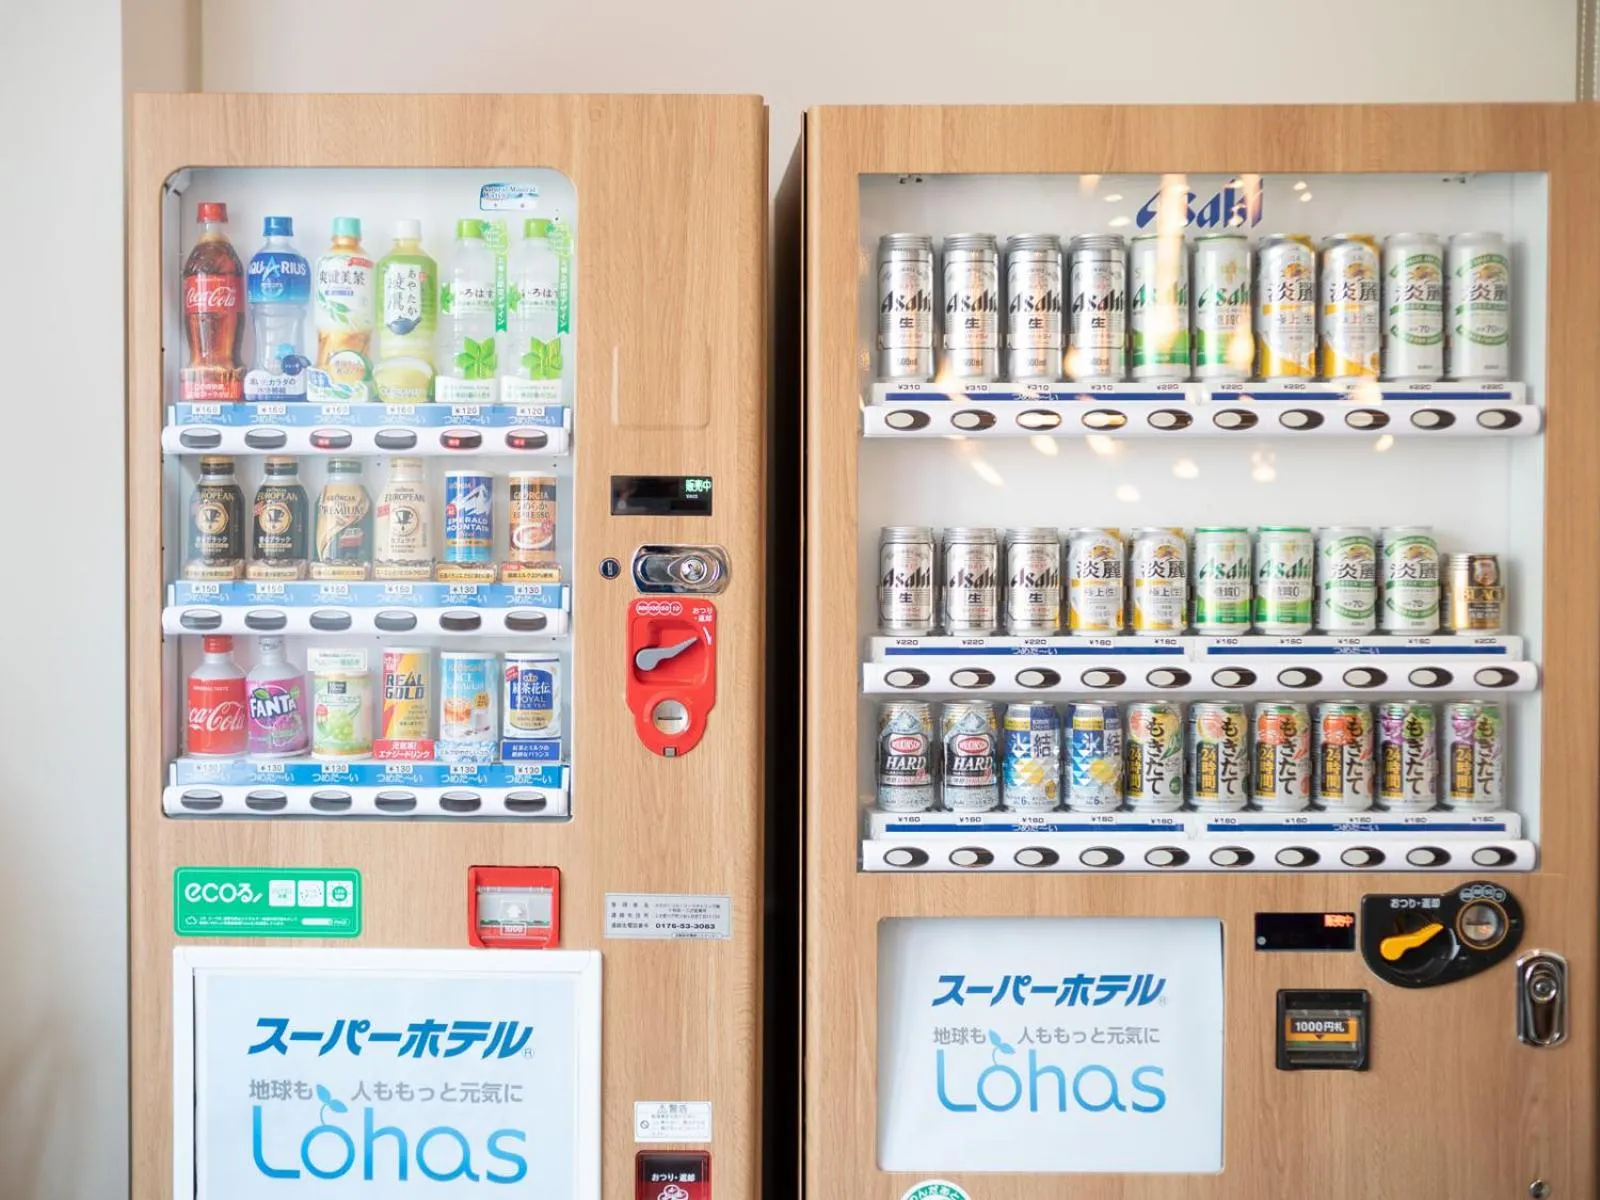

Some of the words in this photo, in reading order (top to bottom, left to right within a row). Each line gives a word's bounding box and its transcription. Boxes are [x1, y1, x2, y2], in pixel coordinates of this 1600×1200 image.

[250, 256, 307, 281] QUARIUS
[880, 288, 931, 314] Asahi
[946, 288, 997, 314] Asahi
[1009, 288, 1061, 314] Asahi
[1071, 288, 1124, 314] Asahi
[899, 317, 914, 329] 生
[965, 317, 980, 329] 生
[1028, 317, 1043, 329] 生
[1090, 317, 1106, 329] 生
[882, 567, 930, 588] Asahi
[950, 567, 996, 588] Asahi
[1010, 567, 1058, 588] Asahi
[898, 592, 913, 604] 生
[967, 592, 982, 604] 生
[1028, 592, 1043, 604] 生
[250, 694, 297, 718] FANTA
[886, 756, 927, 770] HARD
[952, 756, 993, 770] HARD
[1145, 716, 1165, 795] もぎたて
[1221, 716, 1239, 795] もぎたて
[1278, 716, 1297, 795] もぎたて
[1345, 716, 1364, 795] もぎたて
[1405, 716, 1424, 795] もぎたて
[1476, 716, 1495, 795] もぎたて
[931, 973, 1167, 1007] スーパーホテル
[248, 1017, 534, 1059] スーパーホテル
[933, 1026, 987, 1045] 地球も
[1017, 1026, 1160, 1045] 人ももっと元気に
[1295, 1020, 1345, 1032] 1000円札
[249, 1078, 314, 1101] 地球も
[350, 1080, 524, 1103] 人ももっと元気に
[936, 1049, 1167, 1113] Lohas
[252, 1105, 528, 1184] Lohas
